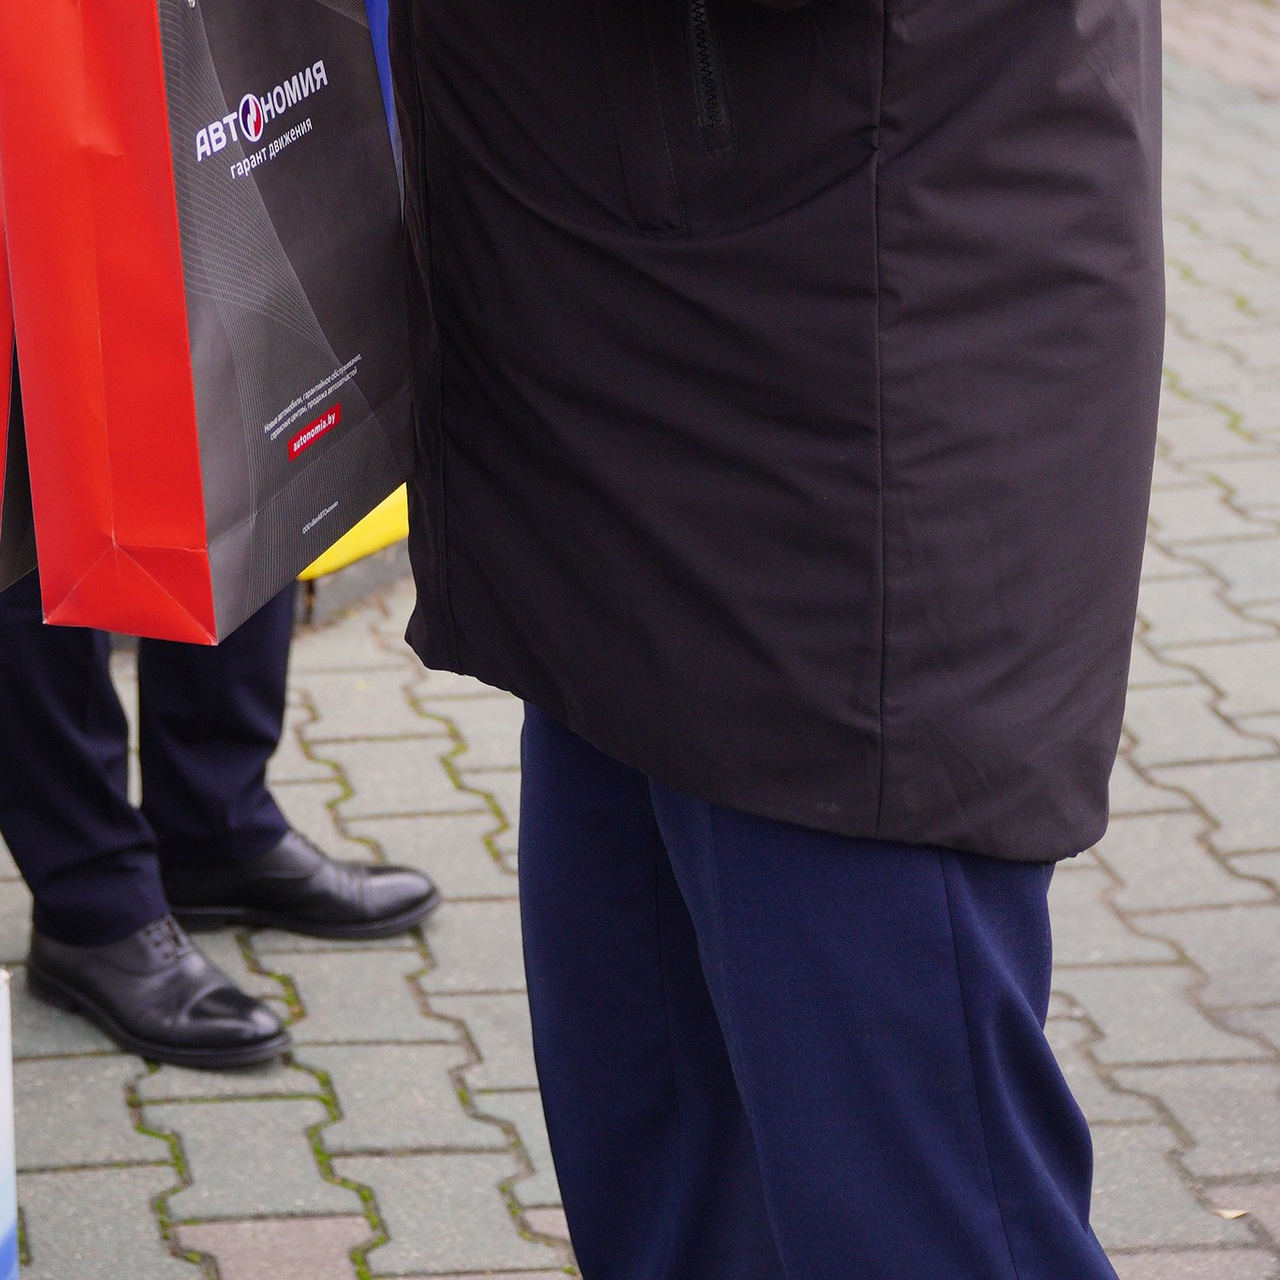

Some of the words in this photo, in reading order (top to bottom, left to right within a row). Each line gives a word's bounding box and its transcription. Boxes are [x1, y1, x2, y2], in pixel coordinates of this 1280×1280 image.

[195, 59, 328, 161] АВТОНОМИЯ
[230, 147, 267, 179] гарант
[268, 118, 313, 160] движения
[293, 412, 336, 452] autonomia.by
